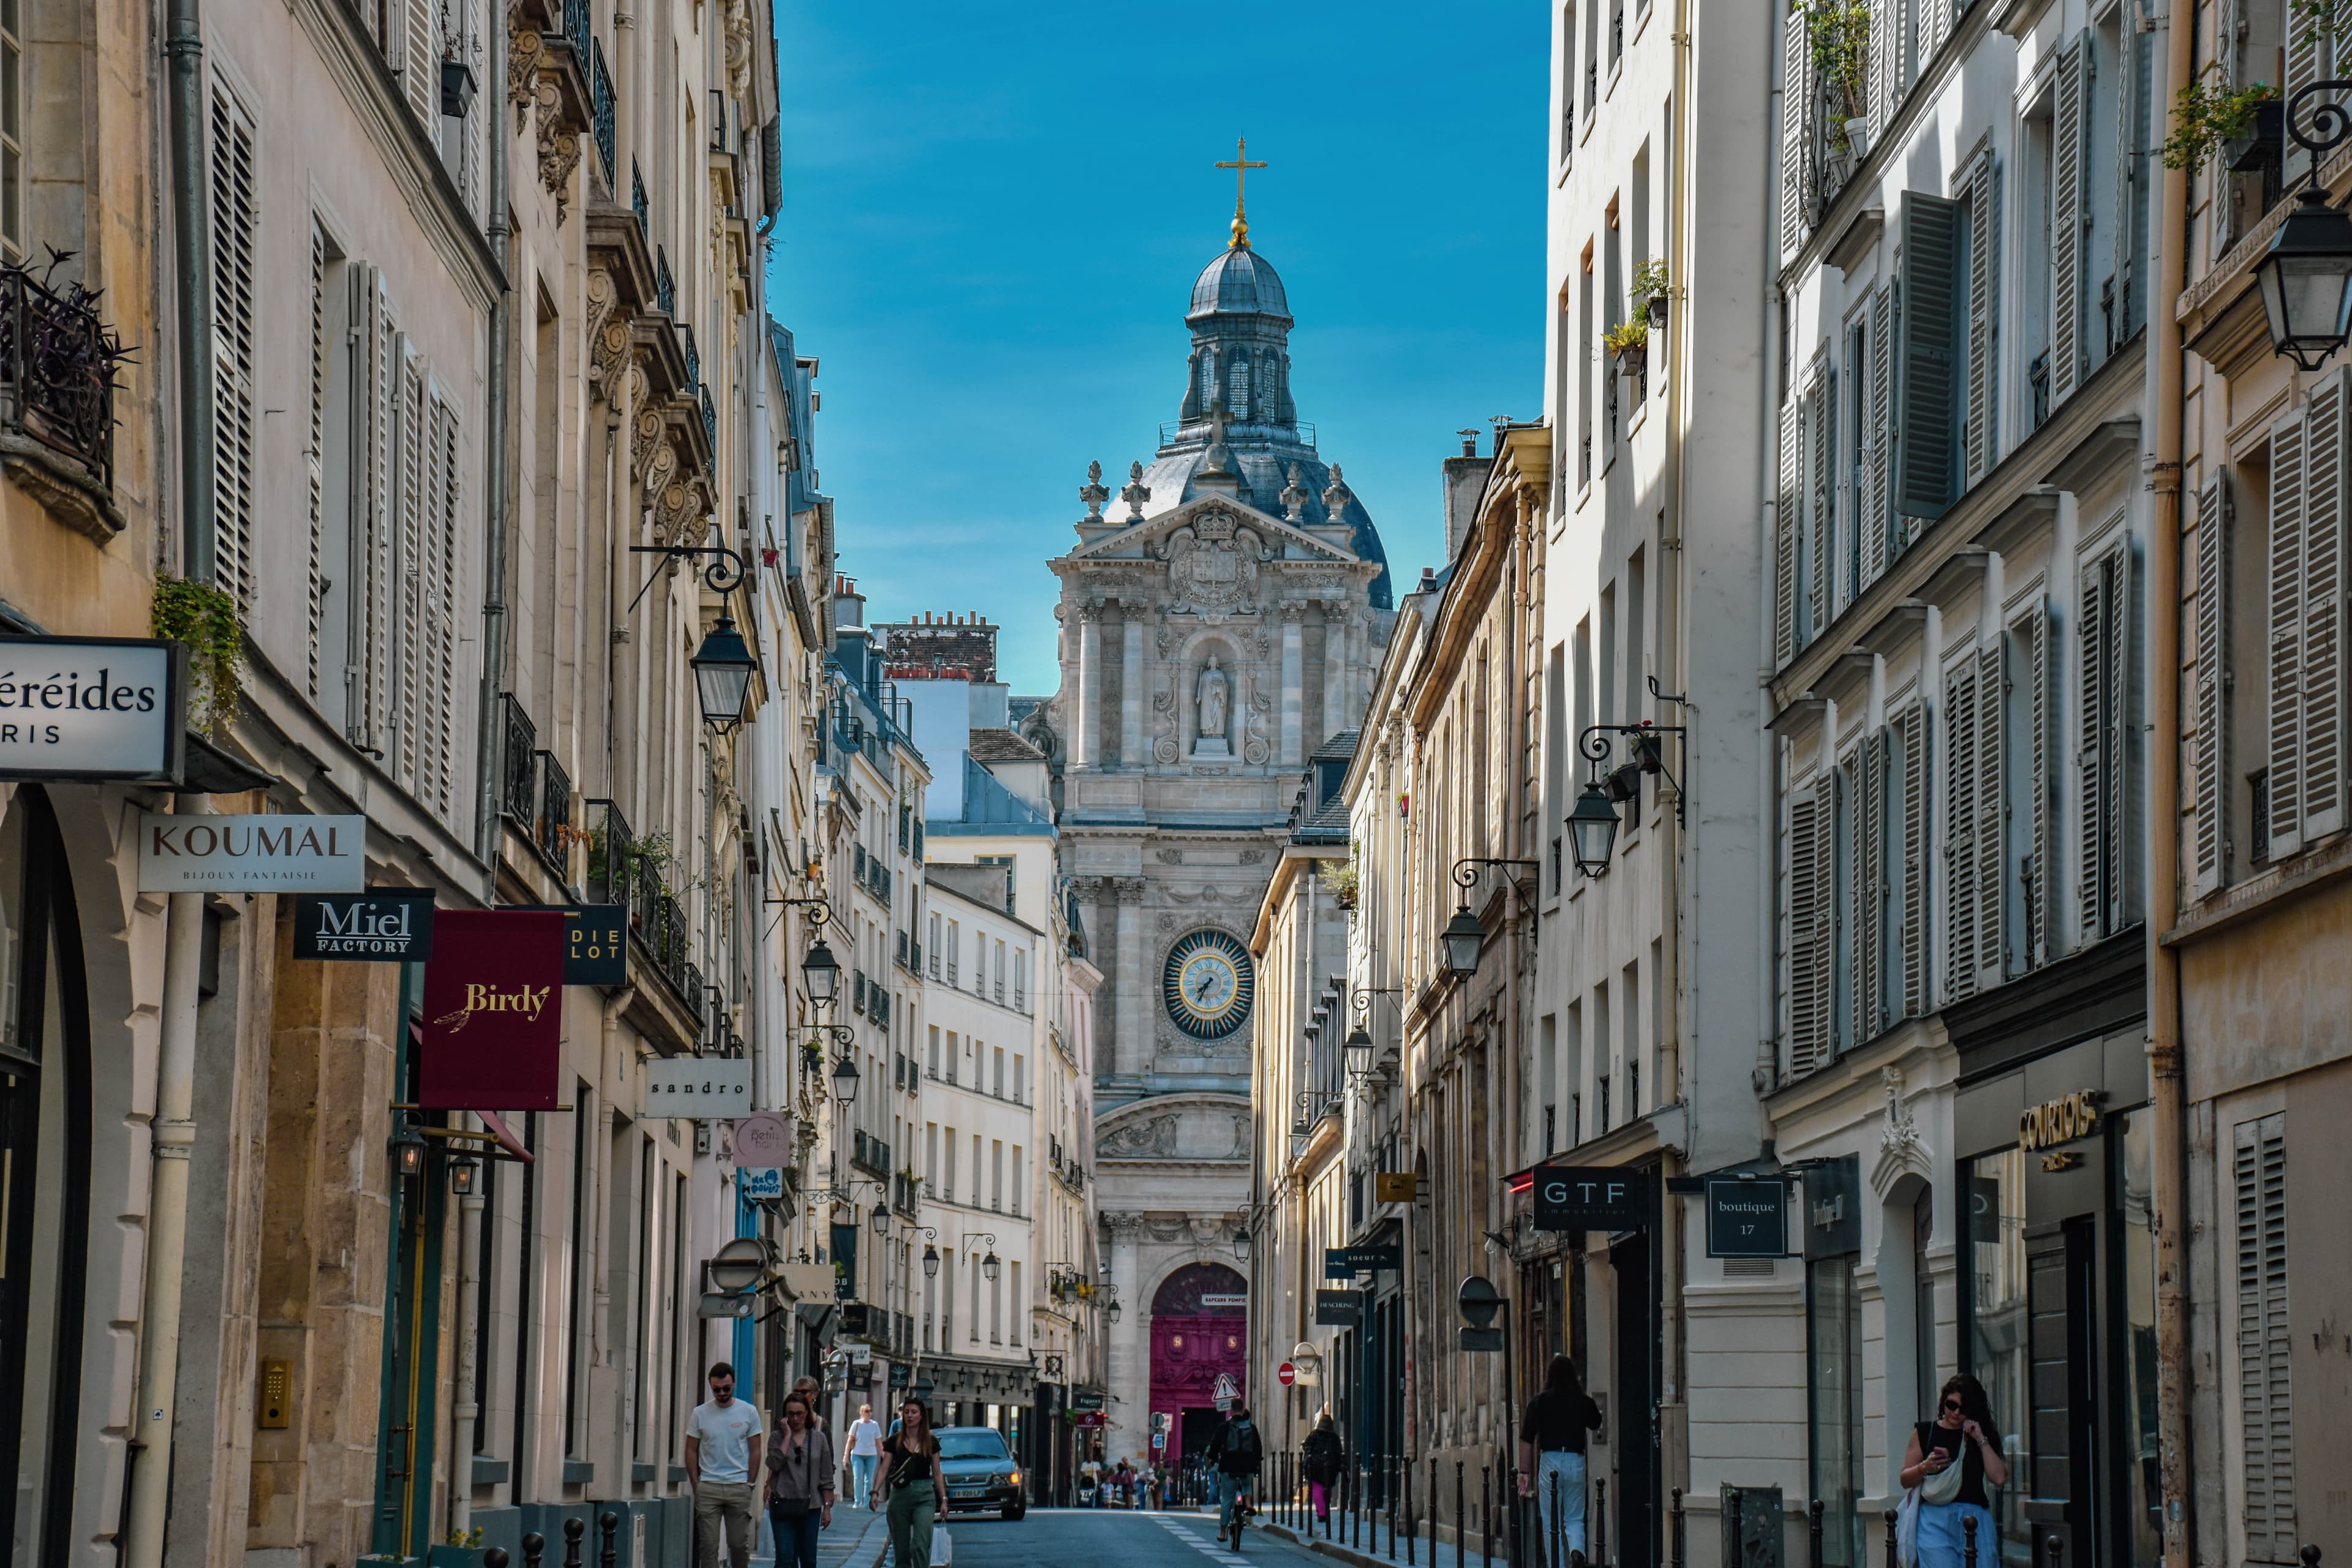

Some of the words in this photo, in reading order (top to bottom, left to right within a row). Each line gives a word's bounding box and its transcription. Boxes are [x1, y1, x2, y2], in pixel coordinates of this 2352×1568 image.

[2, 724, 60, 744] RIS
[153, 826, 349, 856] KOUMAL
[244, 872, 317, 880] FANTAISIE
[316, 902, 412, 936] Miel
[317, 940, 409, 952] FACTORY
[465, 984, 550, 1021] Birdy
[652, 1081, 743, 1093] sandro
[2019, 1088, 2095, 1152] COURTOIS
[1544, 1182, 1625, 1203] GTF
[1719, 1201, 1775, 1215] boutique
[1740, 1225, 1755, 1235] 17
